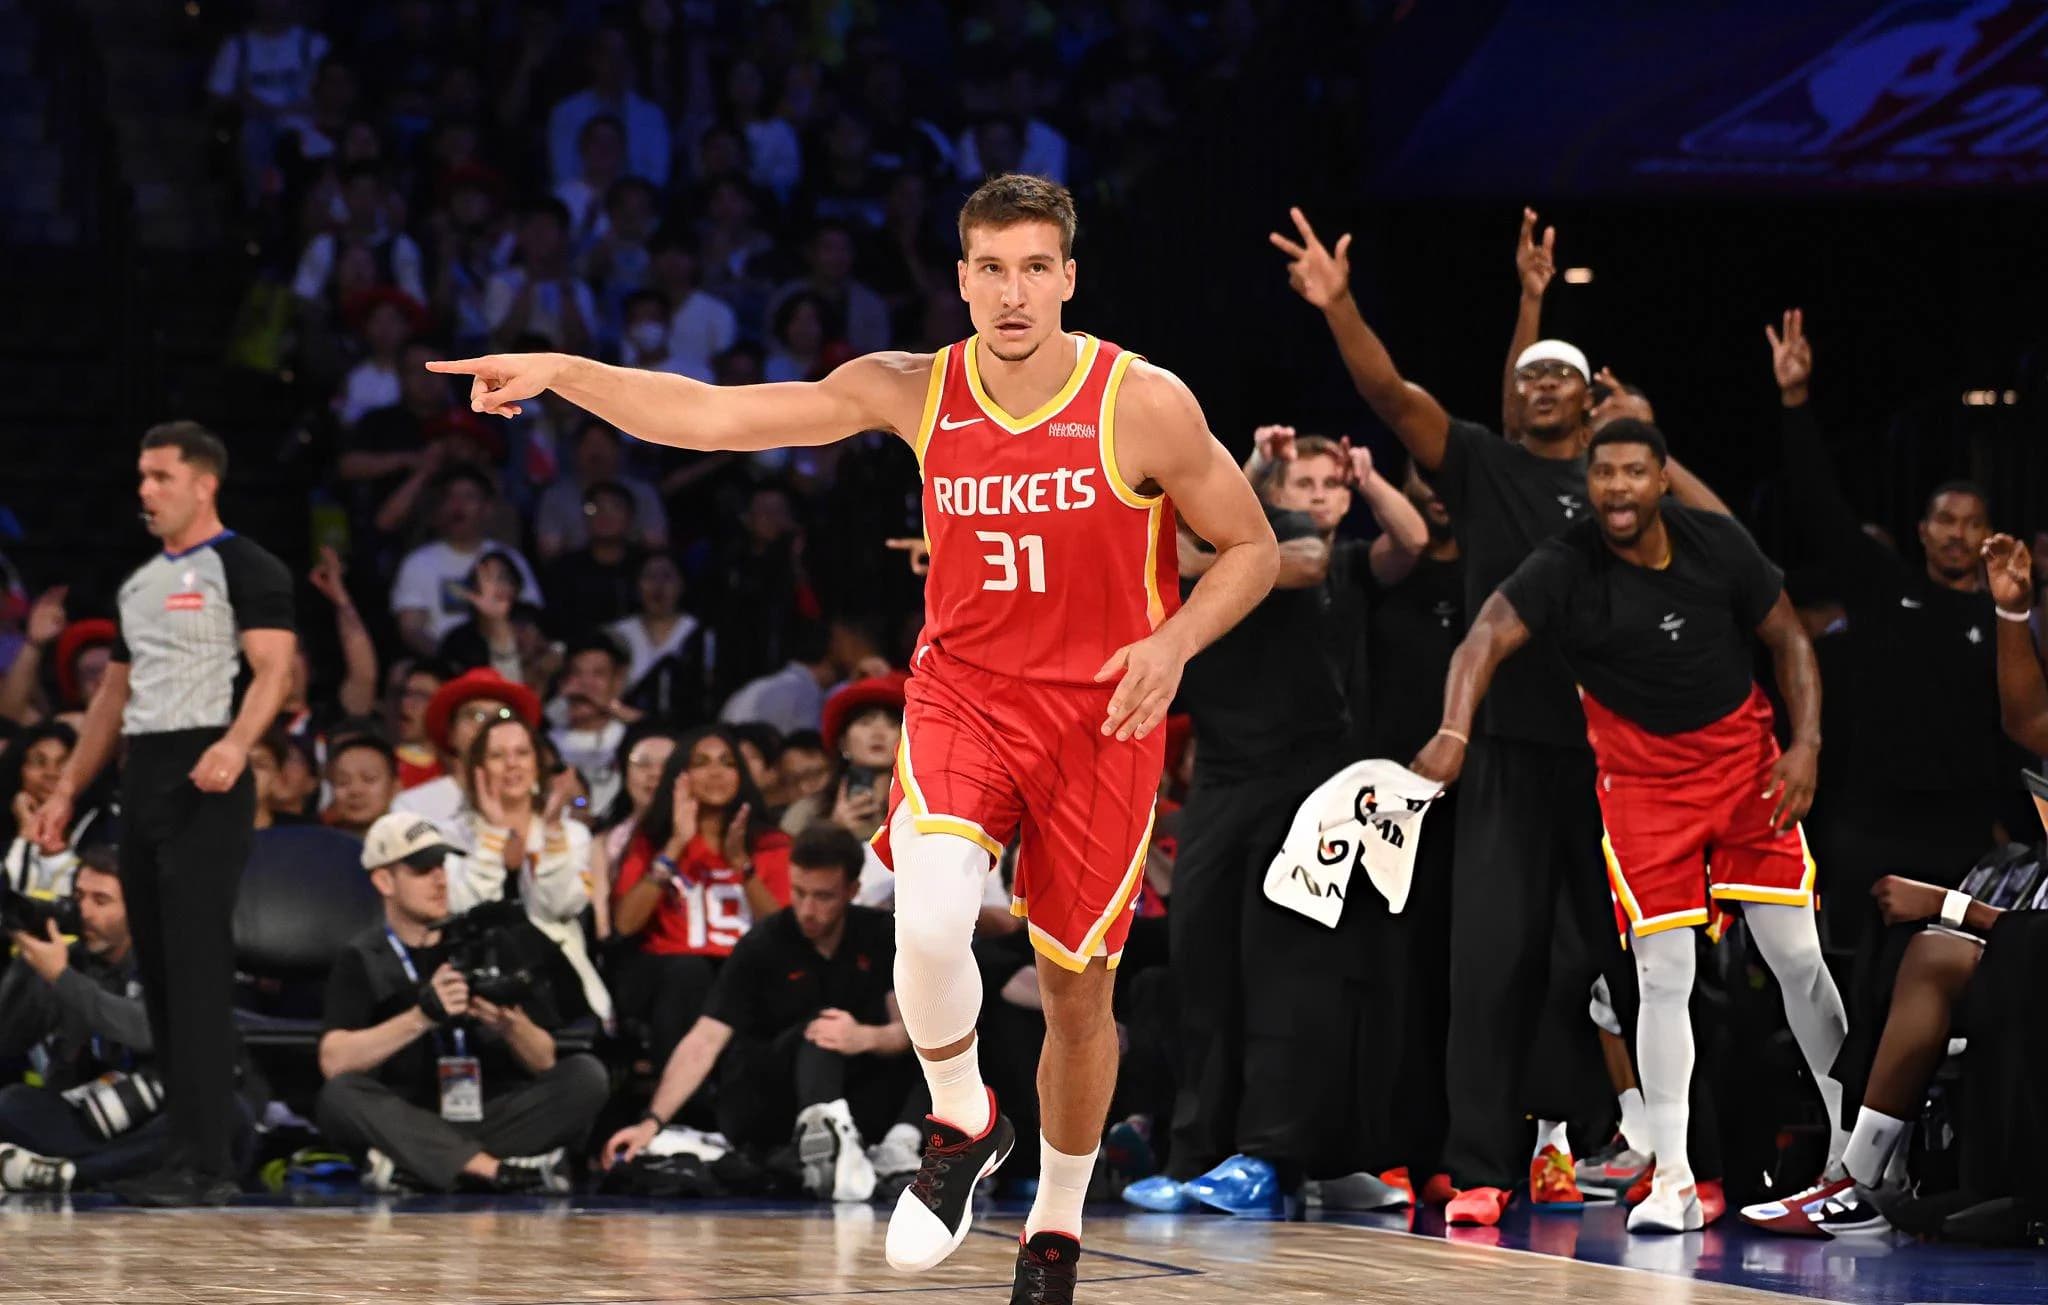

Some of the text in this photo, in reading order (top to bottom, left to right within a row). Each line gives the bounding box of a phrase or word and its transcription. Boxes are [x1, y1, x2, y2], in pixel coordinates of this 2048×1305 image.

[1049, 422, 1095, 432] MEMORIAL
[1049, 429, 1096, 438] HERMANN
[975, 530, 1046, 593] 31
[685, 881, 752, 949] 19
